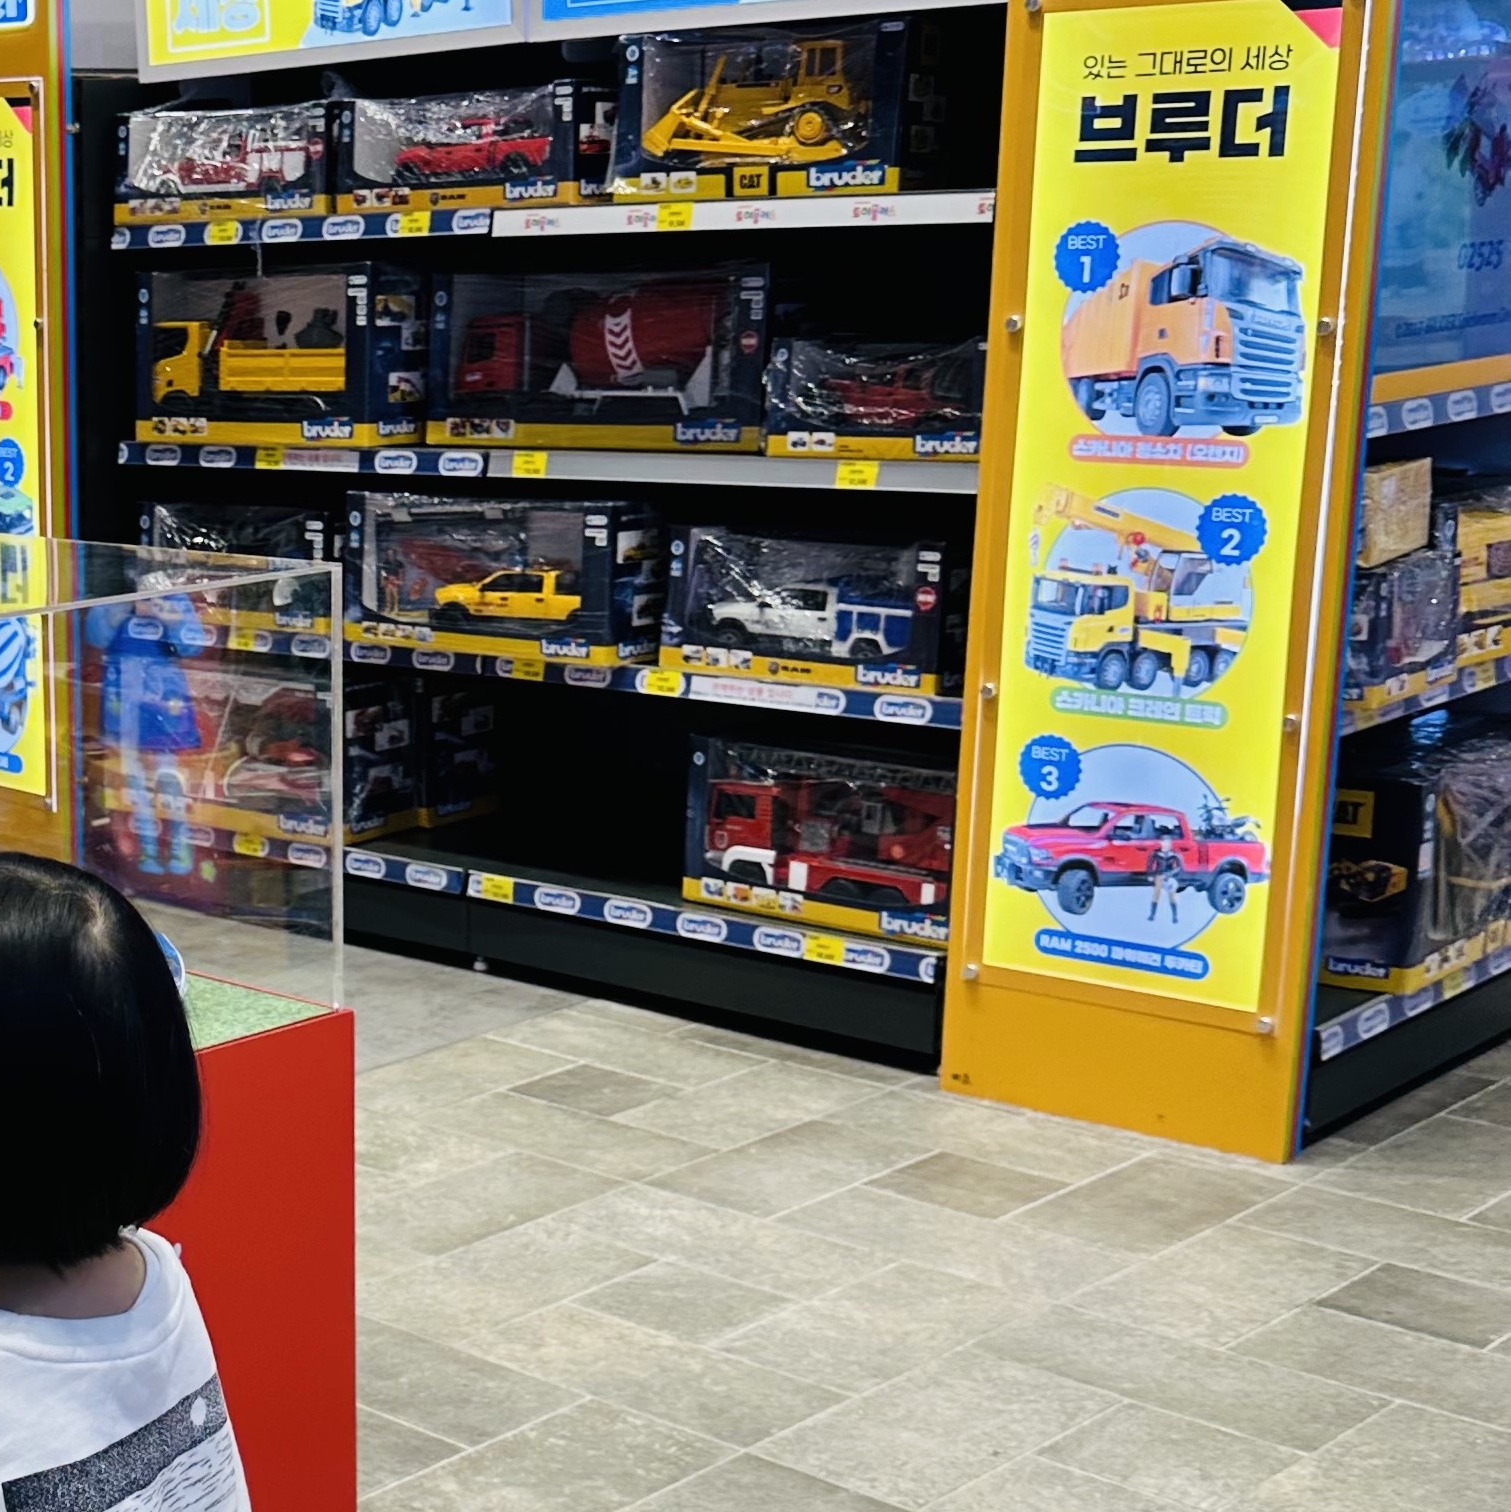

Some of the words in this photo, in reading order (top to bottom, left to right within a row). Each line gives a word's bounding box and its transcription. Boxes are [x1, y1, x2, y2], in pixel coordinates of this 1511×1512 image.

[1082, 53, 1127, 81] 있는
[1135, 48, 1232, 78] 그대로의
[1240, 44, 1293, 73] 세상
[1074, 85, 1290, 164] 브루더
[739, 174, 762, 189] CAT
[808, 164, 885, 187] bruder
[265, 191, 312, 210] bruder
[504, 181, 557, 199] bruder
[1068, 235, 1106, 251] BEST
[1080, 257, 1092, 283] 1
[301, 419, 353, 440] bruder
[377, 420, 417, 436] bruder
[675, 422, 740, 443] bruder
[0, 446, 17, 457] BEST
[915, 434, 977, 454] bruder
[4, 461, 15, 482] 2
[1212, 507, 1251, 524] BEST
[1222, 528, 1240, 557] 2
[541, 639, 588, 658] bruder
[856, 664, 921, 688] bruder
[1032, 746, 1069, 762] BEST
[1041, 765, 1059, 791] 3
[279, 814, 328, 836] bruder
[879, 911, 948, 939] bruder
[1040, 934, 1073, 951] RAM
[1075, 940, 1110, 958] 2500
[1327, 956, 1388, 978] bruder
